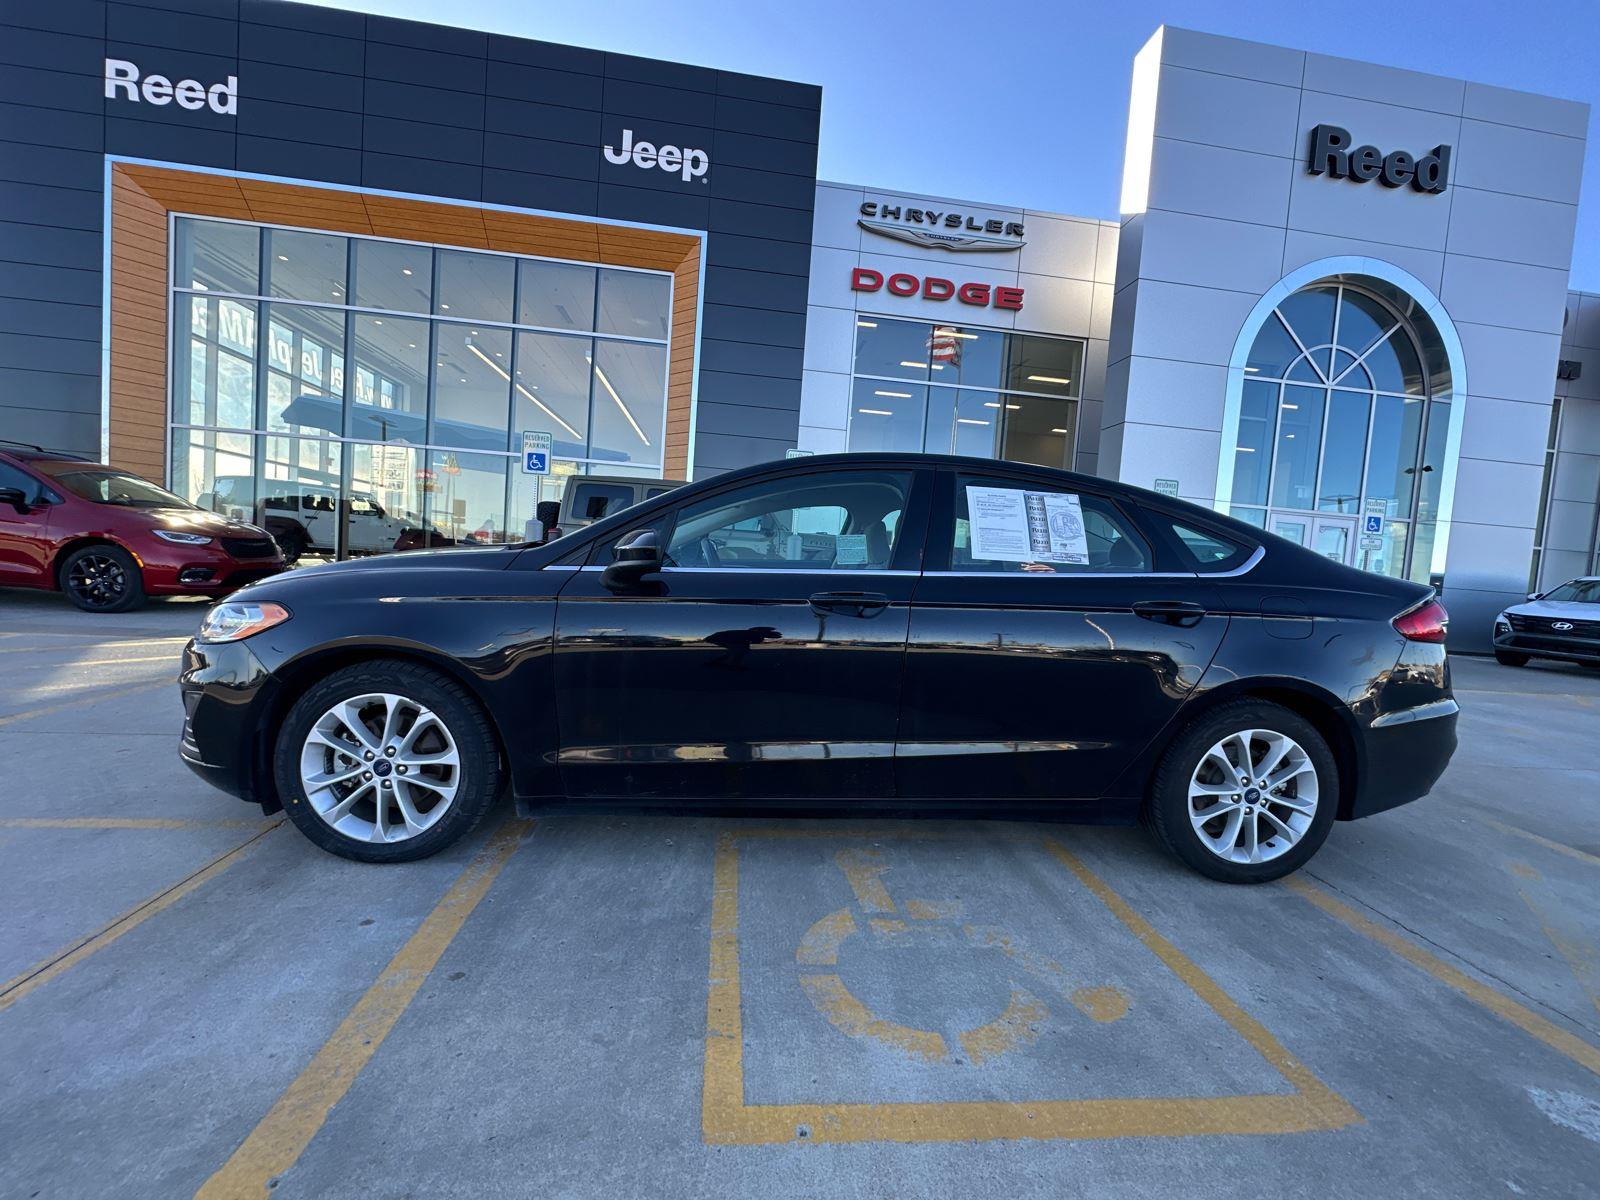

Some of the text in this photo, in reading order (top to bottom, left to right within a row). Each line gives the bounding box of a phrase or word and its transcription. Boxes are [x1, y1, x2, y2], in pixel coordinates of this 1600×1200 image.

[105, 58, 238, 116] Reed
[604, 129, 708, 182] Jeep
[1308, 124, 1451, 195] Reed
[860, 202, 1024, 236] CHRYSLER
[851, 267, 1024, 311] DODGE
[525, 434, 550, 442] RESERVED
